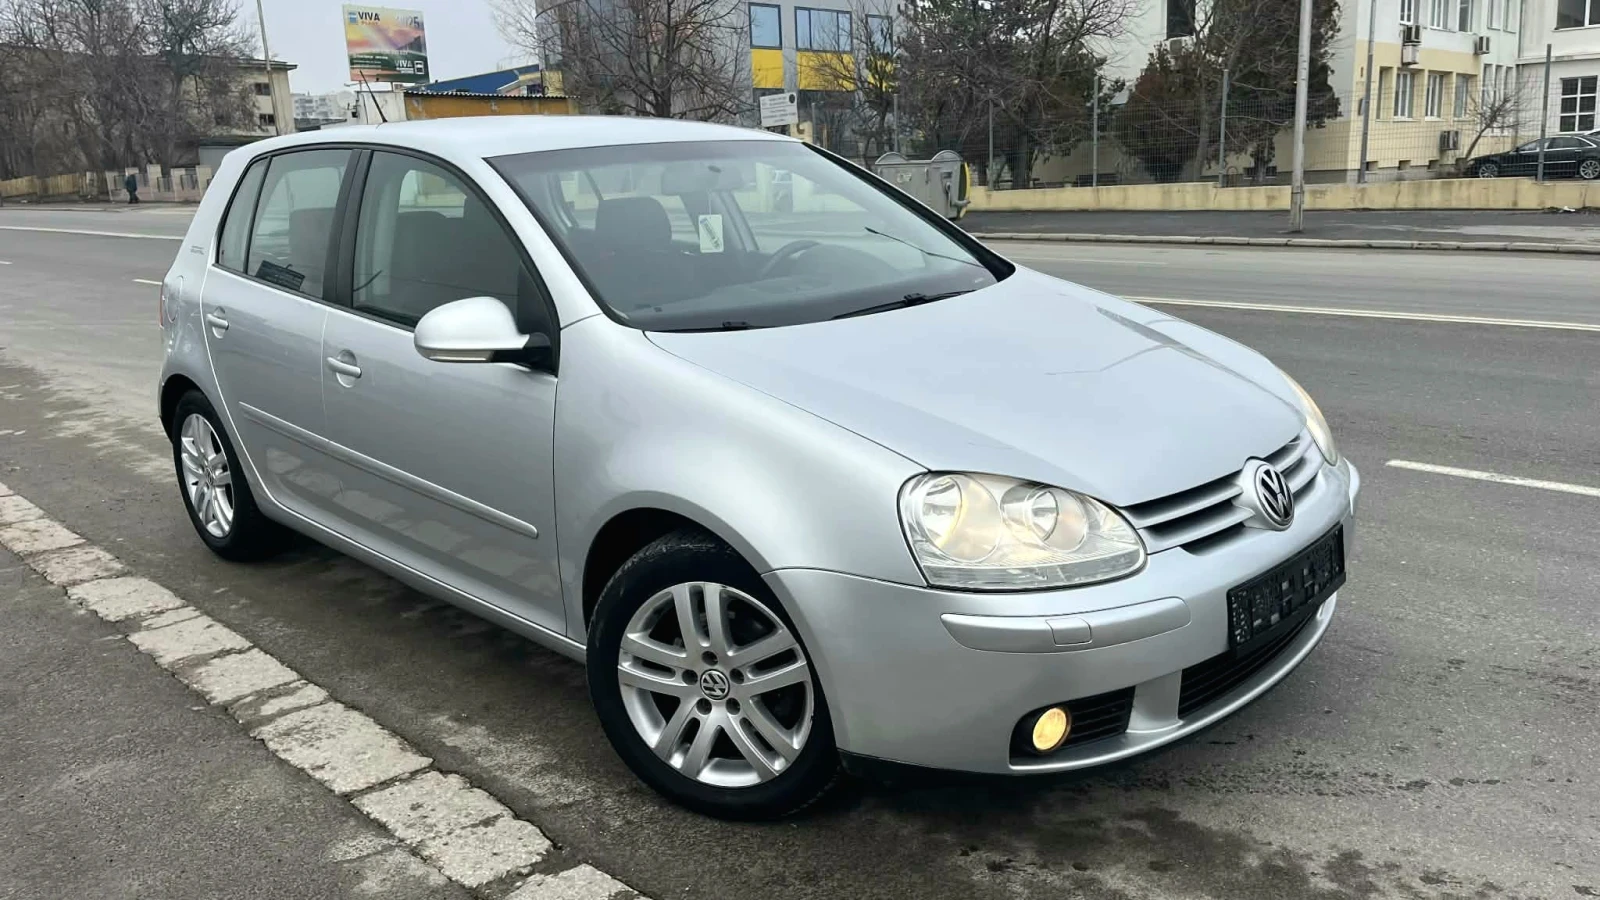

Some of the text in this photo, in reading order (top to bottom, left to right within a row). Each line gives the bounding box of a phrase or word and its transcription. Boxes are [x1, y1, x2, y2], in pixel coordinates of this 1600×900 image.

[358, 11, 380, 21] VIVA
[394, 59, 413, 68] VIVA
[1256, 465, 1294, 524] VW
